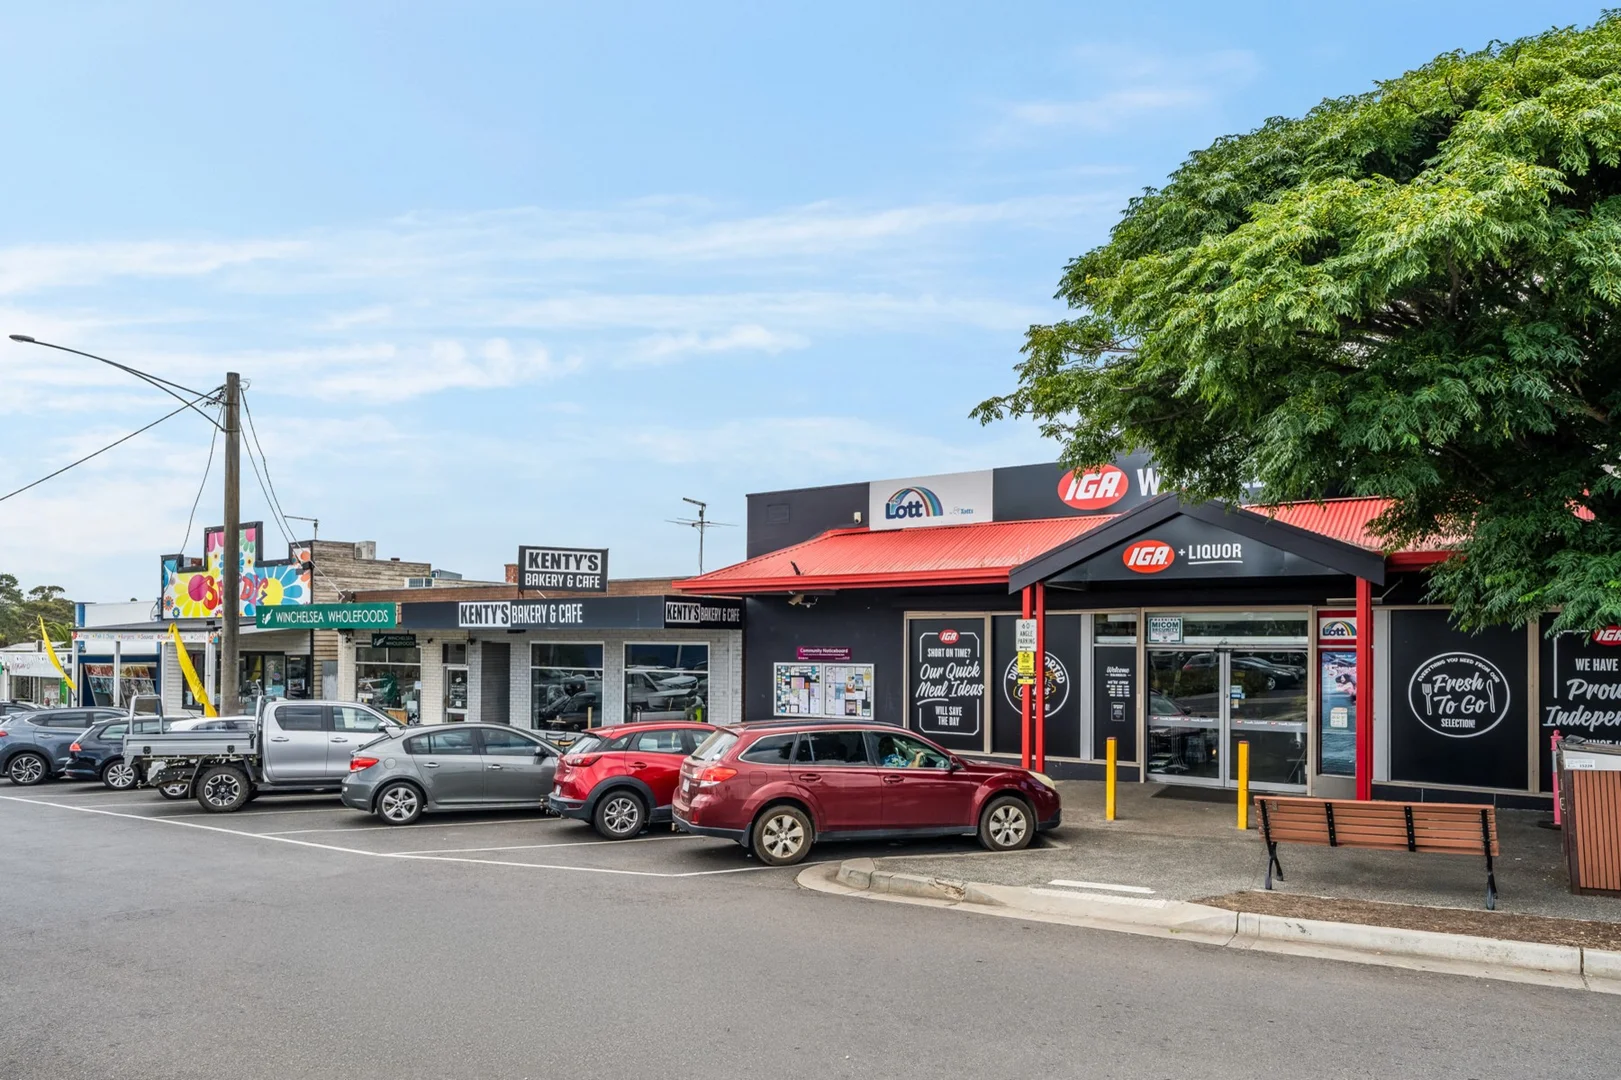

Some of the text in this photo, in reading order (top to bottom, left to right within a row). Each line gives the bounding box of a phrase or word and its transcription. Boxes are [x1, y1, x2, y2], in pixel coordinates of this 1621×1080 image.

[1064, 471, 1122, 501] IGA
[885, 501, 923, 519] Lott
[528, 552, 599, 571] KENTY'S
[1127, 547, 1168, 566] IGA
[1188, 543, 1242, 560] LIQUOR
[525, 573, 600, 588] BAKERY & CAFE
[275, 610, 389, 623] WINCHELSEA WHOLEFOODS
[460, 603, 583, 625] KENTY'S BAKERY & CAFE
[667, 604, 700, 621] KENTY'S
[700, 607, 722, 622] BAKERY
[727, 608, 740, 622] CAFE
[1152, 621, 1179, 629] MICOM
[1322, 627, 1346, 636] Lott
[941, 632, 958, 641] IGA
[927, 648, 971, 658] SHORT ON TIME?
[920, 660, 981, 681] Our Quick
[1417, 659, 1446, 682] EVERYTHING
[1459, 657, 1474, 665] NEED
[1474, 661, 1491, 673] FROM
[1490, 671, 1500, 683] OUR
[1575, 658, 1619, 671] WE HAVE
[915, 680, 985, 698] Meal Ideas
[1432, 672, 1484, 693] Fresh
[935, 706, 963, 716] WILL SAVE
[1433, 694, 1488, 715] To Go
[938, 716, 960, 726] THE DAY
[1440, 718, 1476, 728] SELECTION!
